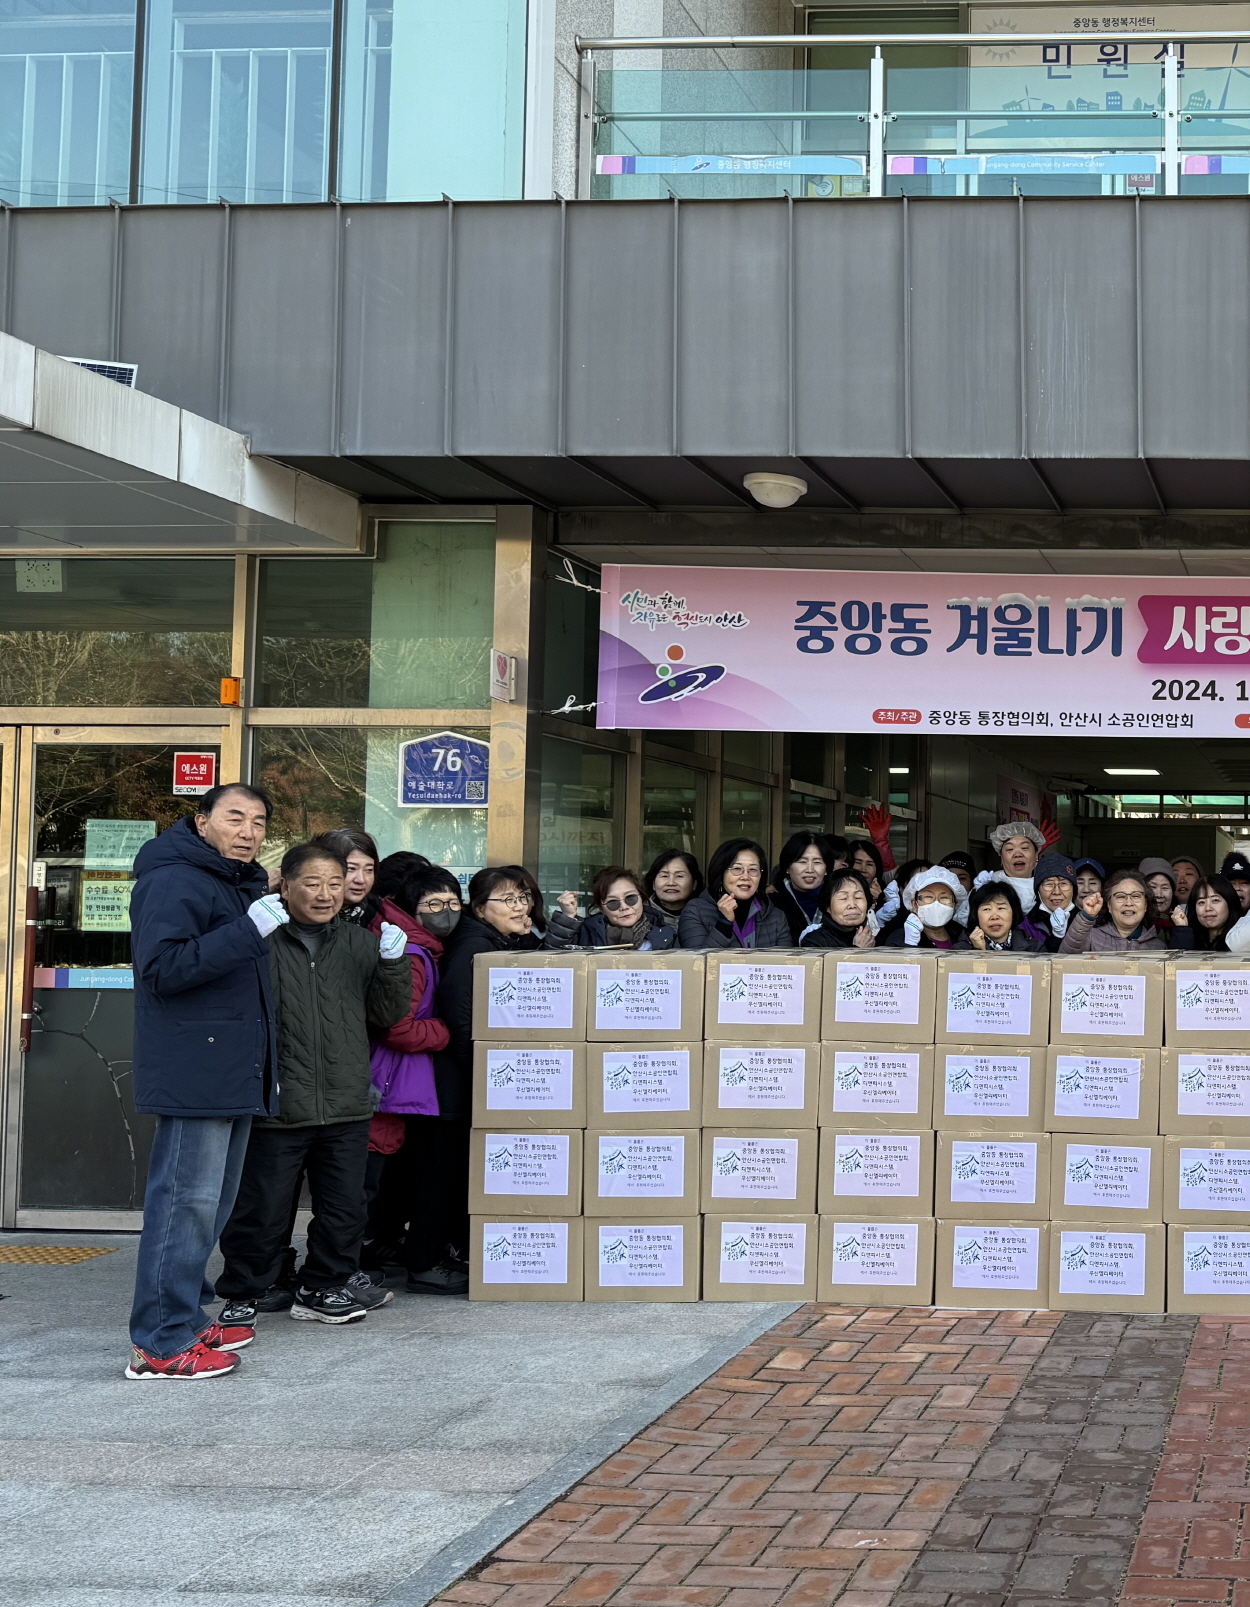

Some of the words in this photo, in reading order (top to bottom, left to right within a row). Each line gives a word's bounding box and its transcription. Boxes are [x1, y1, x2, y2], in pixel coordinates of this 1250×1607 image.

[1073, 17, 1099, 28] 중앙동
[1102, 17, 1155, 27] 행정복지센터
[986, 161, 1026, 170] ungang-dong
[622, 590, 659, 612] 시민과
[632, 611, 668, 630] 자유로운
[672, 611, 712, 628] 혁신도시
[715, 612, 748, 628] 안산
[794, 600, 932, 657] 중앙동
[946, 602, 1123, 657] 겨울나기
[1151, 679, 1225, 702] 2024.
[877, 710, 918, 722] 주최/주관
[928, 710, 972, 726] 중앙동
[977, 711, 1054, 728] 통장협의회,
[1059, 712, 1102, 728] 안산시
[1107, 713, 1194, 729] 소공인연합회
[431, 749, 462, 772] 76
[181, 763, 207, 775] 에스원
[407, 780, 454, 791] 예술대학로
[86, 885, 109, 895] 수수료
[79, 975, 123, 984] Jungang-dong
